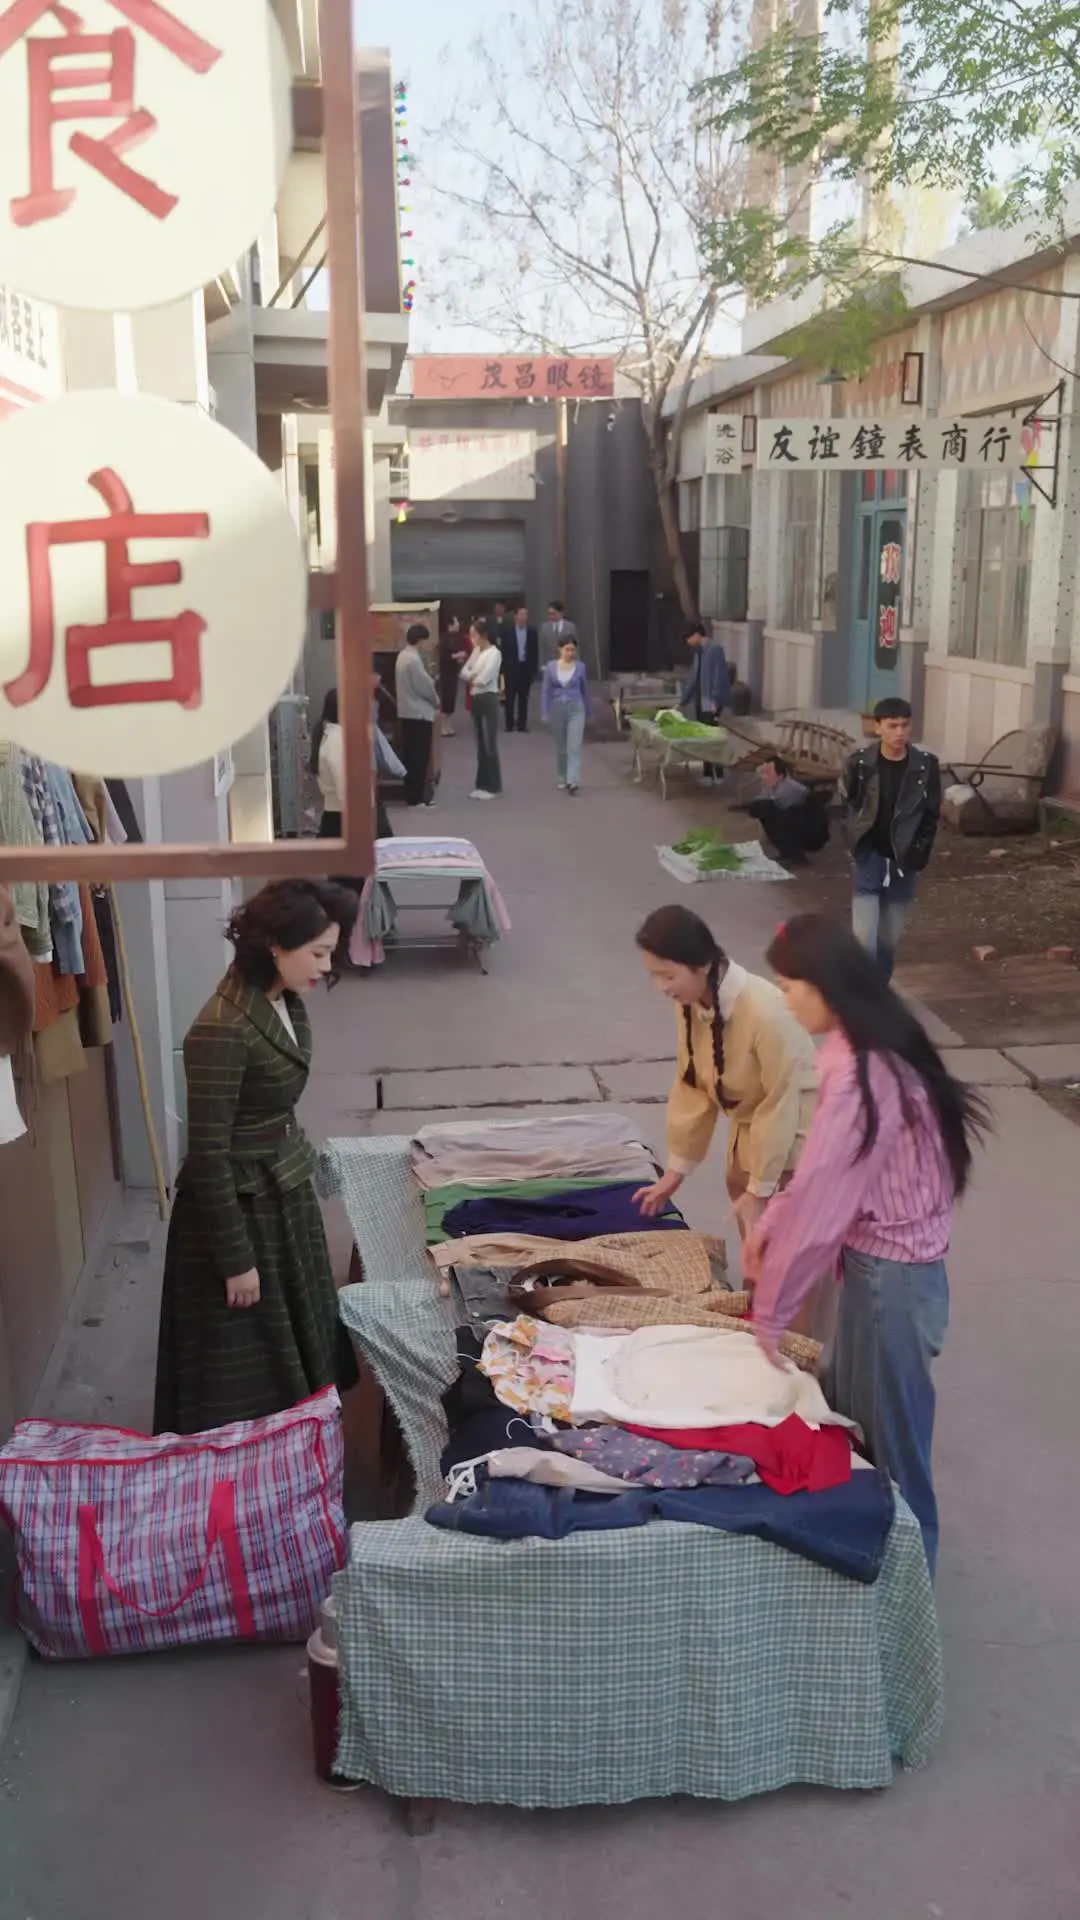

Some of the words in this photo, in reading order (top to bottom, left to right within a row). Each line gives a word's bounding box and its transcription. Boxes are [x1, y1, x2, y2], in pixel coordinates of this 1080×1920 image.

[479, 363, 609, 391] 茂昌眼镜
[715, 423, 737, 465] 洗浴
[768, 423, 1012, 462] 友谊鐘表商行
